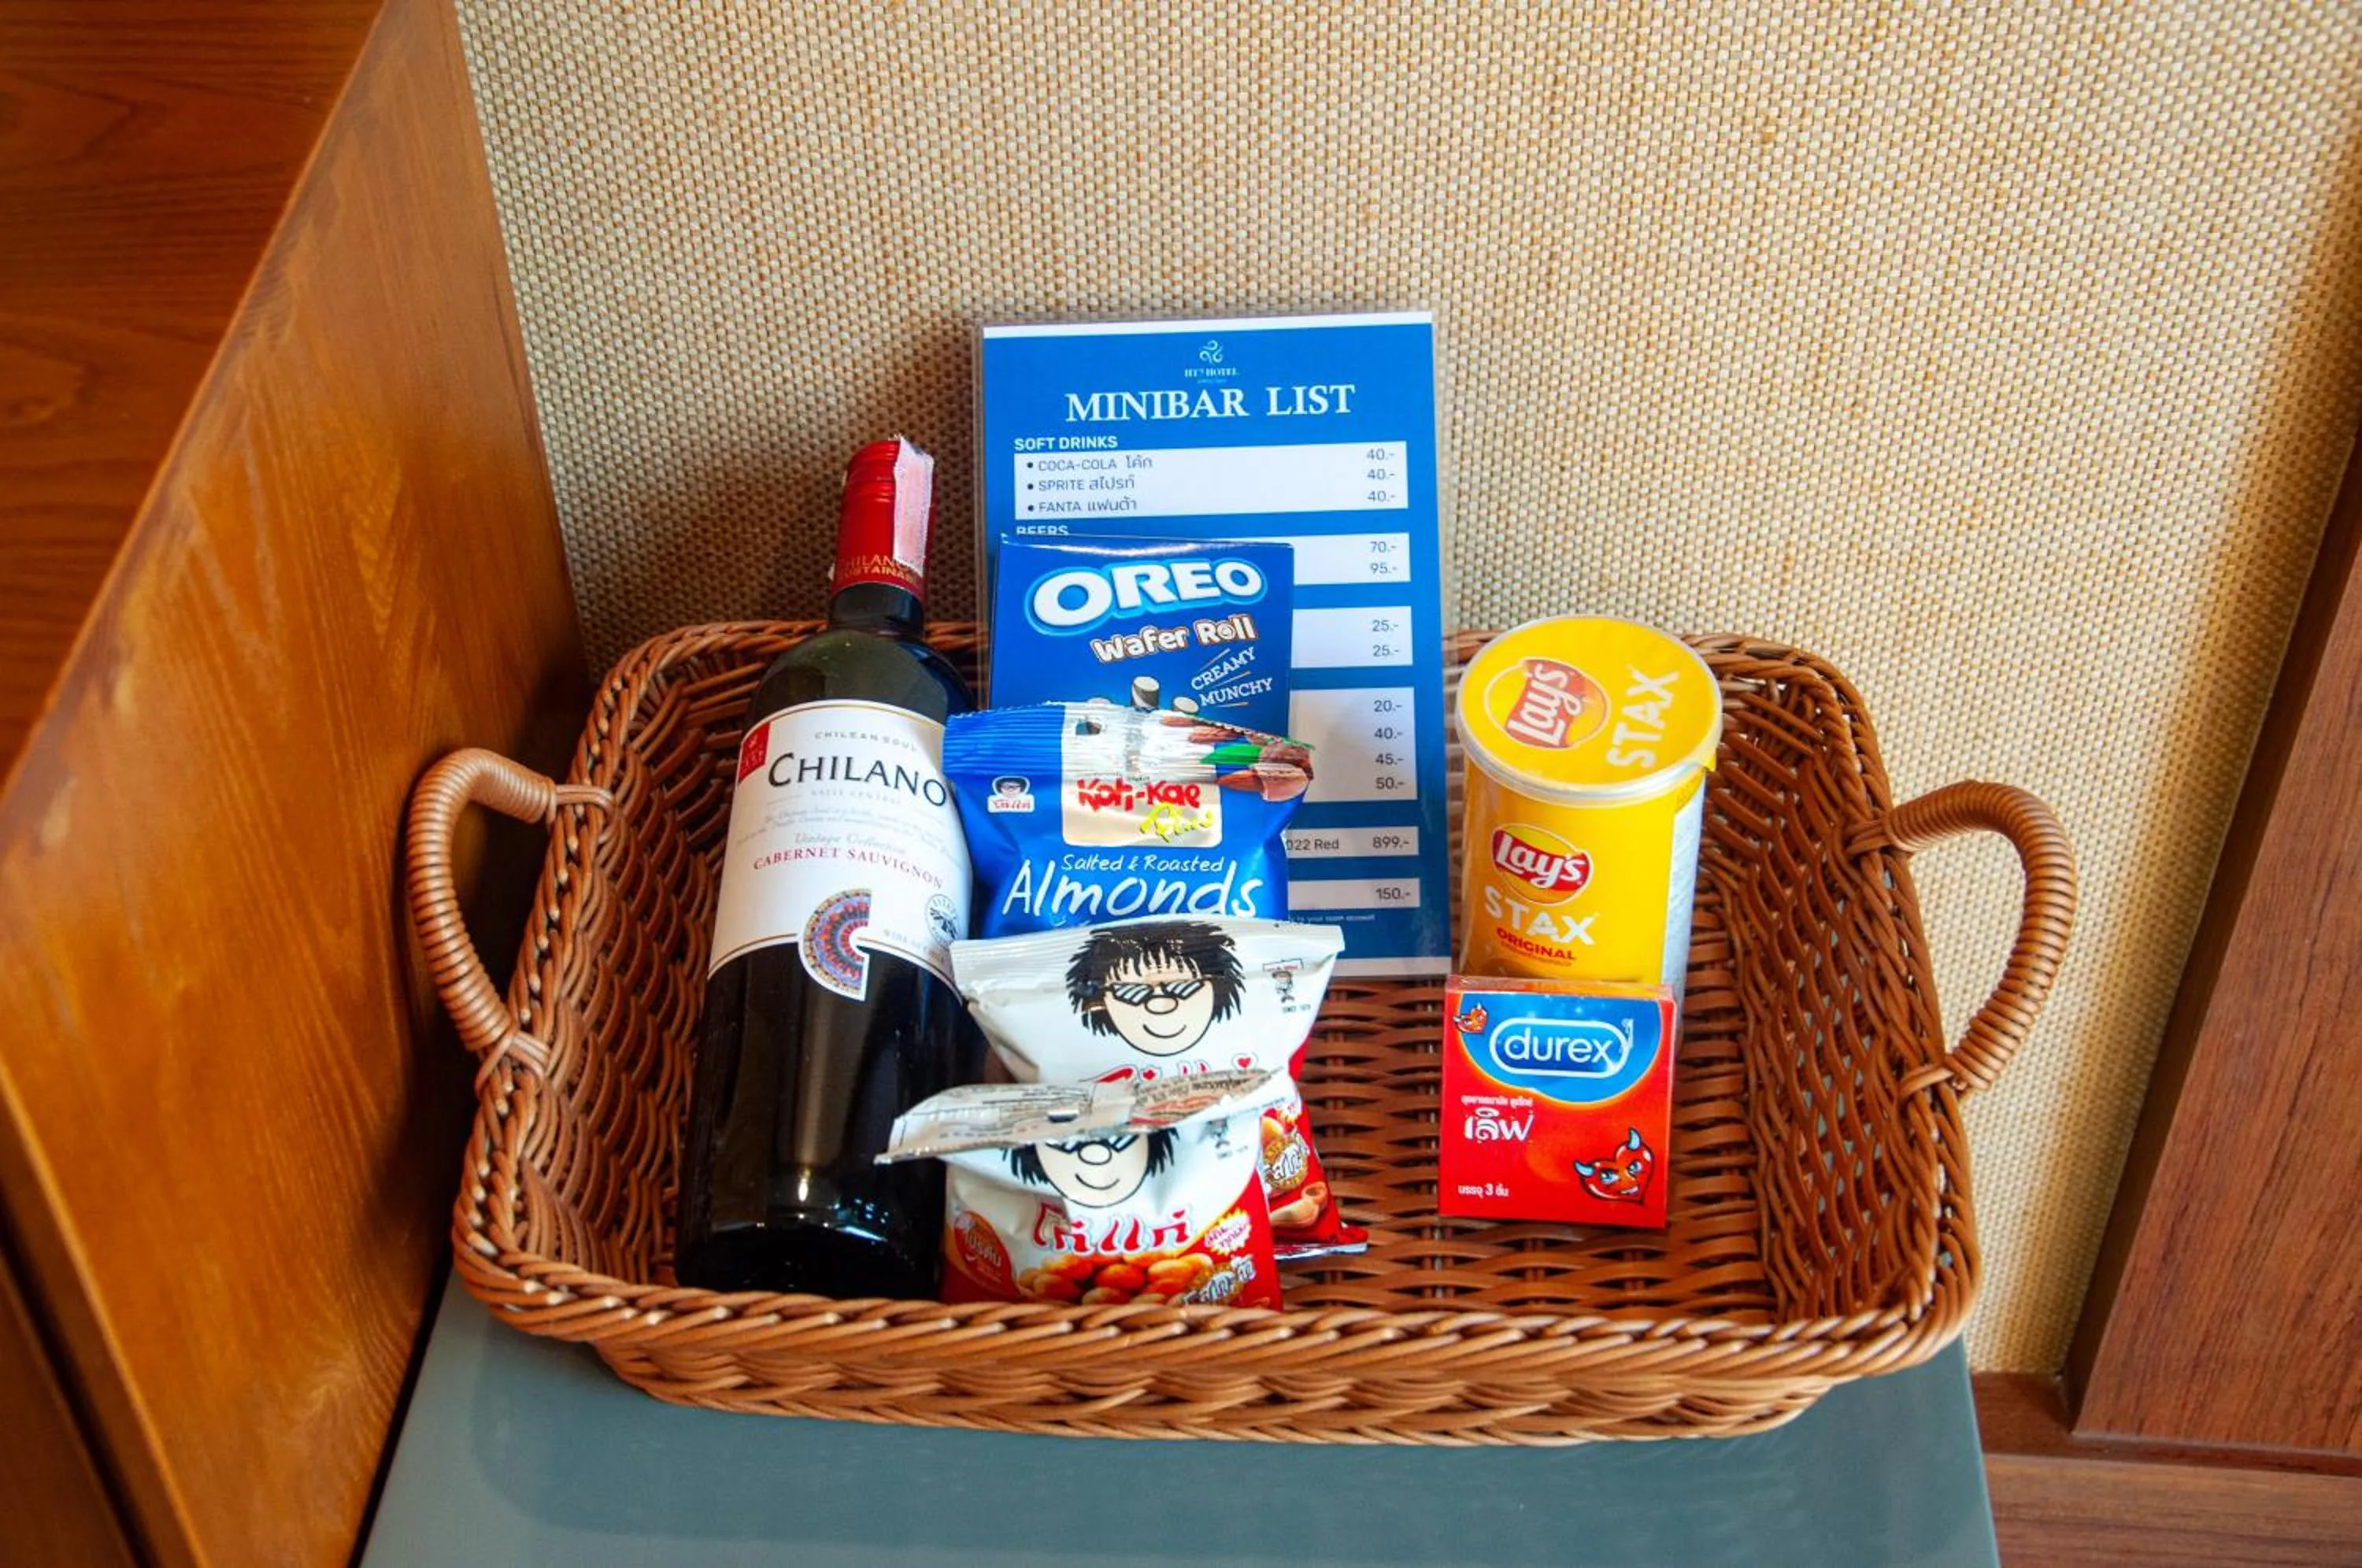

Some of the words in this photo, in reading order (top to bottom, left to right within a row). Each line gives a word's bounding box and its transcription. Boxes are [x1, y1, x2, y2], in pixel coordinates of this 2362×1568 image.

[1065, 389, 1249, 423] MINIBAR
[1267, 384, 1355, 415] LIST
[1014, 437, 1055, 451] SOFT
[1059, 435, 1118, 449] DRINKS
[1366, 448, 1395, 460] 40.-
[1038, 459, 1117, 472] COCA-COLA
[1367, 468, 1395, 480] 40.-
[1038, 479, 1085, 491] SPRITE
[1367, 490, 1396, 502] 40.-
[1038, 501, 1082, 512] FANTA
[1370, 541, 1397, 553] 70.-
[1370, 563, 1397, 575] 95.-
[1033, 560, 1262, 627] OREO
[1372, 619, 1399, 632] 25.-
[1090, 625, 1190, 663] Wafer
[1194, 614, 1257, 645] Roll
[1373, 645, 1400, 657] 25.-
[1190, 646, 1257, 691] CREAMY
[1198, 678, 1273, 707] MUNCHY
[1374, 700, 1403, 712] 20.-
[1505, 662, 1583, 747] Lay's
[1606, 669, 1679, 767] STAX
[814, 730, 880, 742] CHILEAN
[1374, 727, 1404, 739] 40.-
[1375, 753, 1405, 764] 45.-
[768, 753, 946, 807] CHILANO
[1375, 777, 1405, 790] 50.-
[1285, 839, 1311, 851] 022
[1314, 838, 1339, 850] Red
[1372, 836, 1409, 849] 899.-
[753, 847, 841, 870] CABERNET
[846, 849, 944, 889] SAUVIGNON
[1061, 853, 1122, 872] Salted
[1143, 854, 1225, 873] Roasted
[1495, 834, 1584, 888] Lay's
[1002, 860, 1263, 918] Almonds
[1376, 888, 1411, 900] 150.-
[1485, 885, 1596, 945] STAX
[1497, 927, 1577, 960] ORIGINAL
[1504, 1026, 1616, 1066] durex
[1464, 1107, 1535, 1142] เลิฟ
[1485, 1183, 1494, 1196] 3
